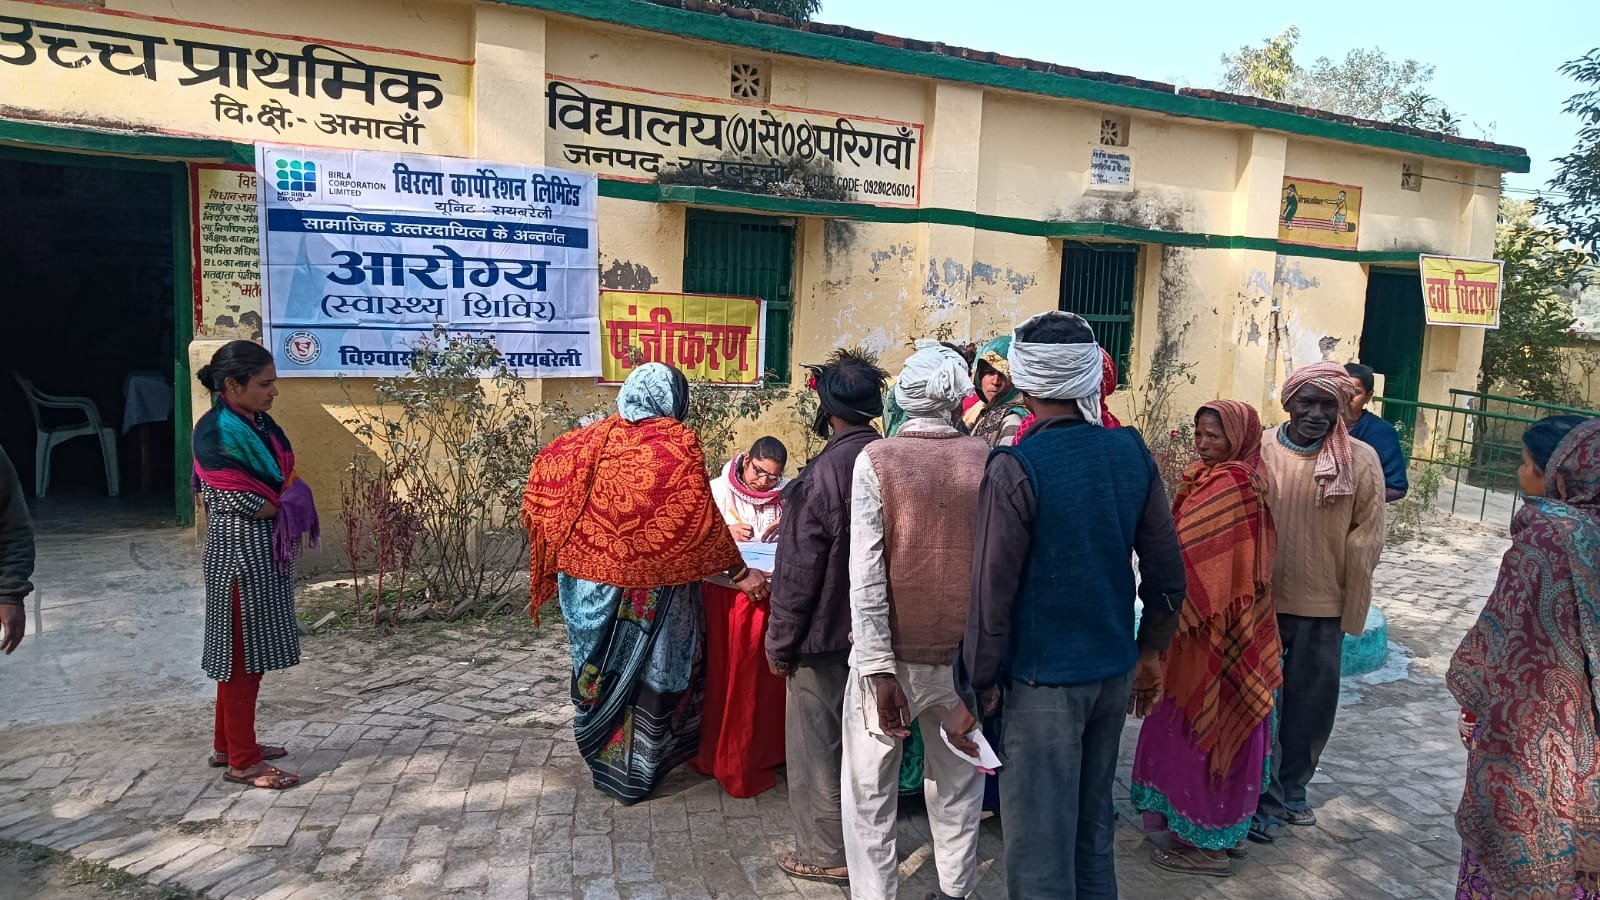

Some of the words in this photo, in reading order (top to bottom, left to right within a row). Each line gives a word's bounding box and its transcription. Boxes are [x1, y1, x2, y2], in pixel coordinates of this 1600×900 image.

[0, 15, 168, 82] उच्च
[173, 38, 445, 112] प्राथमिक
[328, 171, 352, 180] BIRLA
[328, 180, 387, 190] CORPORATION
[392, 162, 445, 196] बिरला
[531, 173, 582, 207] लिमिटेड
[328, 188, 362, 197] LIMITED
[434, 199, 476, 216] यूनिट
[492, 204, 552, 219] रायबरेली
[301, 215, 387, 233] सामाजिक
[391, 222, 487, 240] उत्तरदायित्व
[492, 224, 508, 240] के
[513, 228, 566, 245] अन्तर्गत
[326, 245, 552, 292] आरोग्य
[321, 294, 446, 318] (स्वास्थ्य
[461, 291, 556, 323] शिविर)
[1426, 278, 1451, 314] दवा
[1454, 269, 1498, 317] वितरण
[605, 304, 752, 371] पंजीकरण
